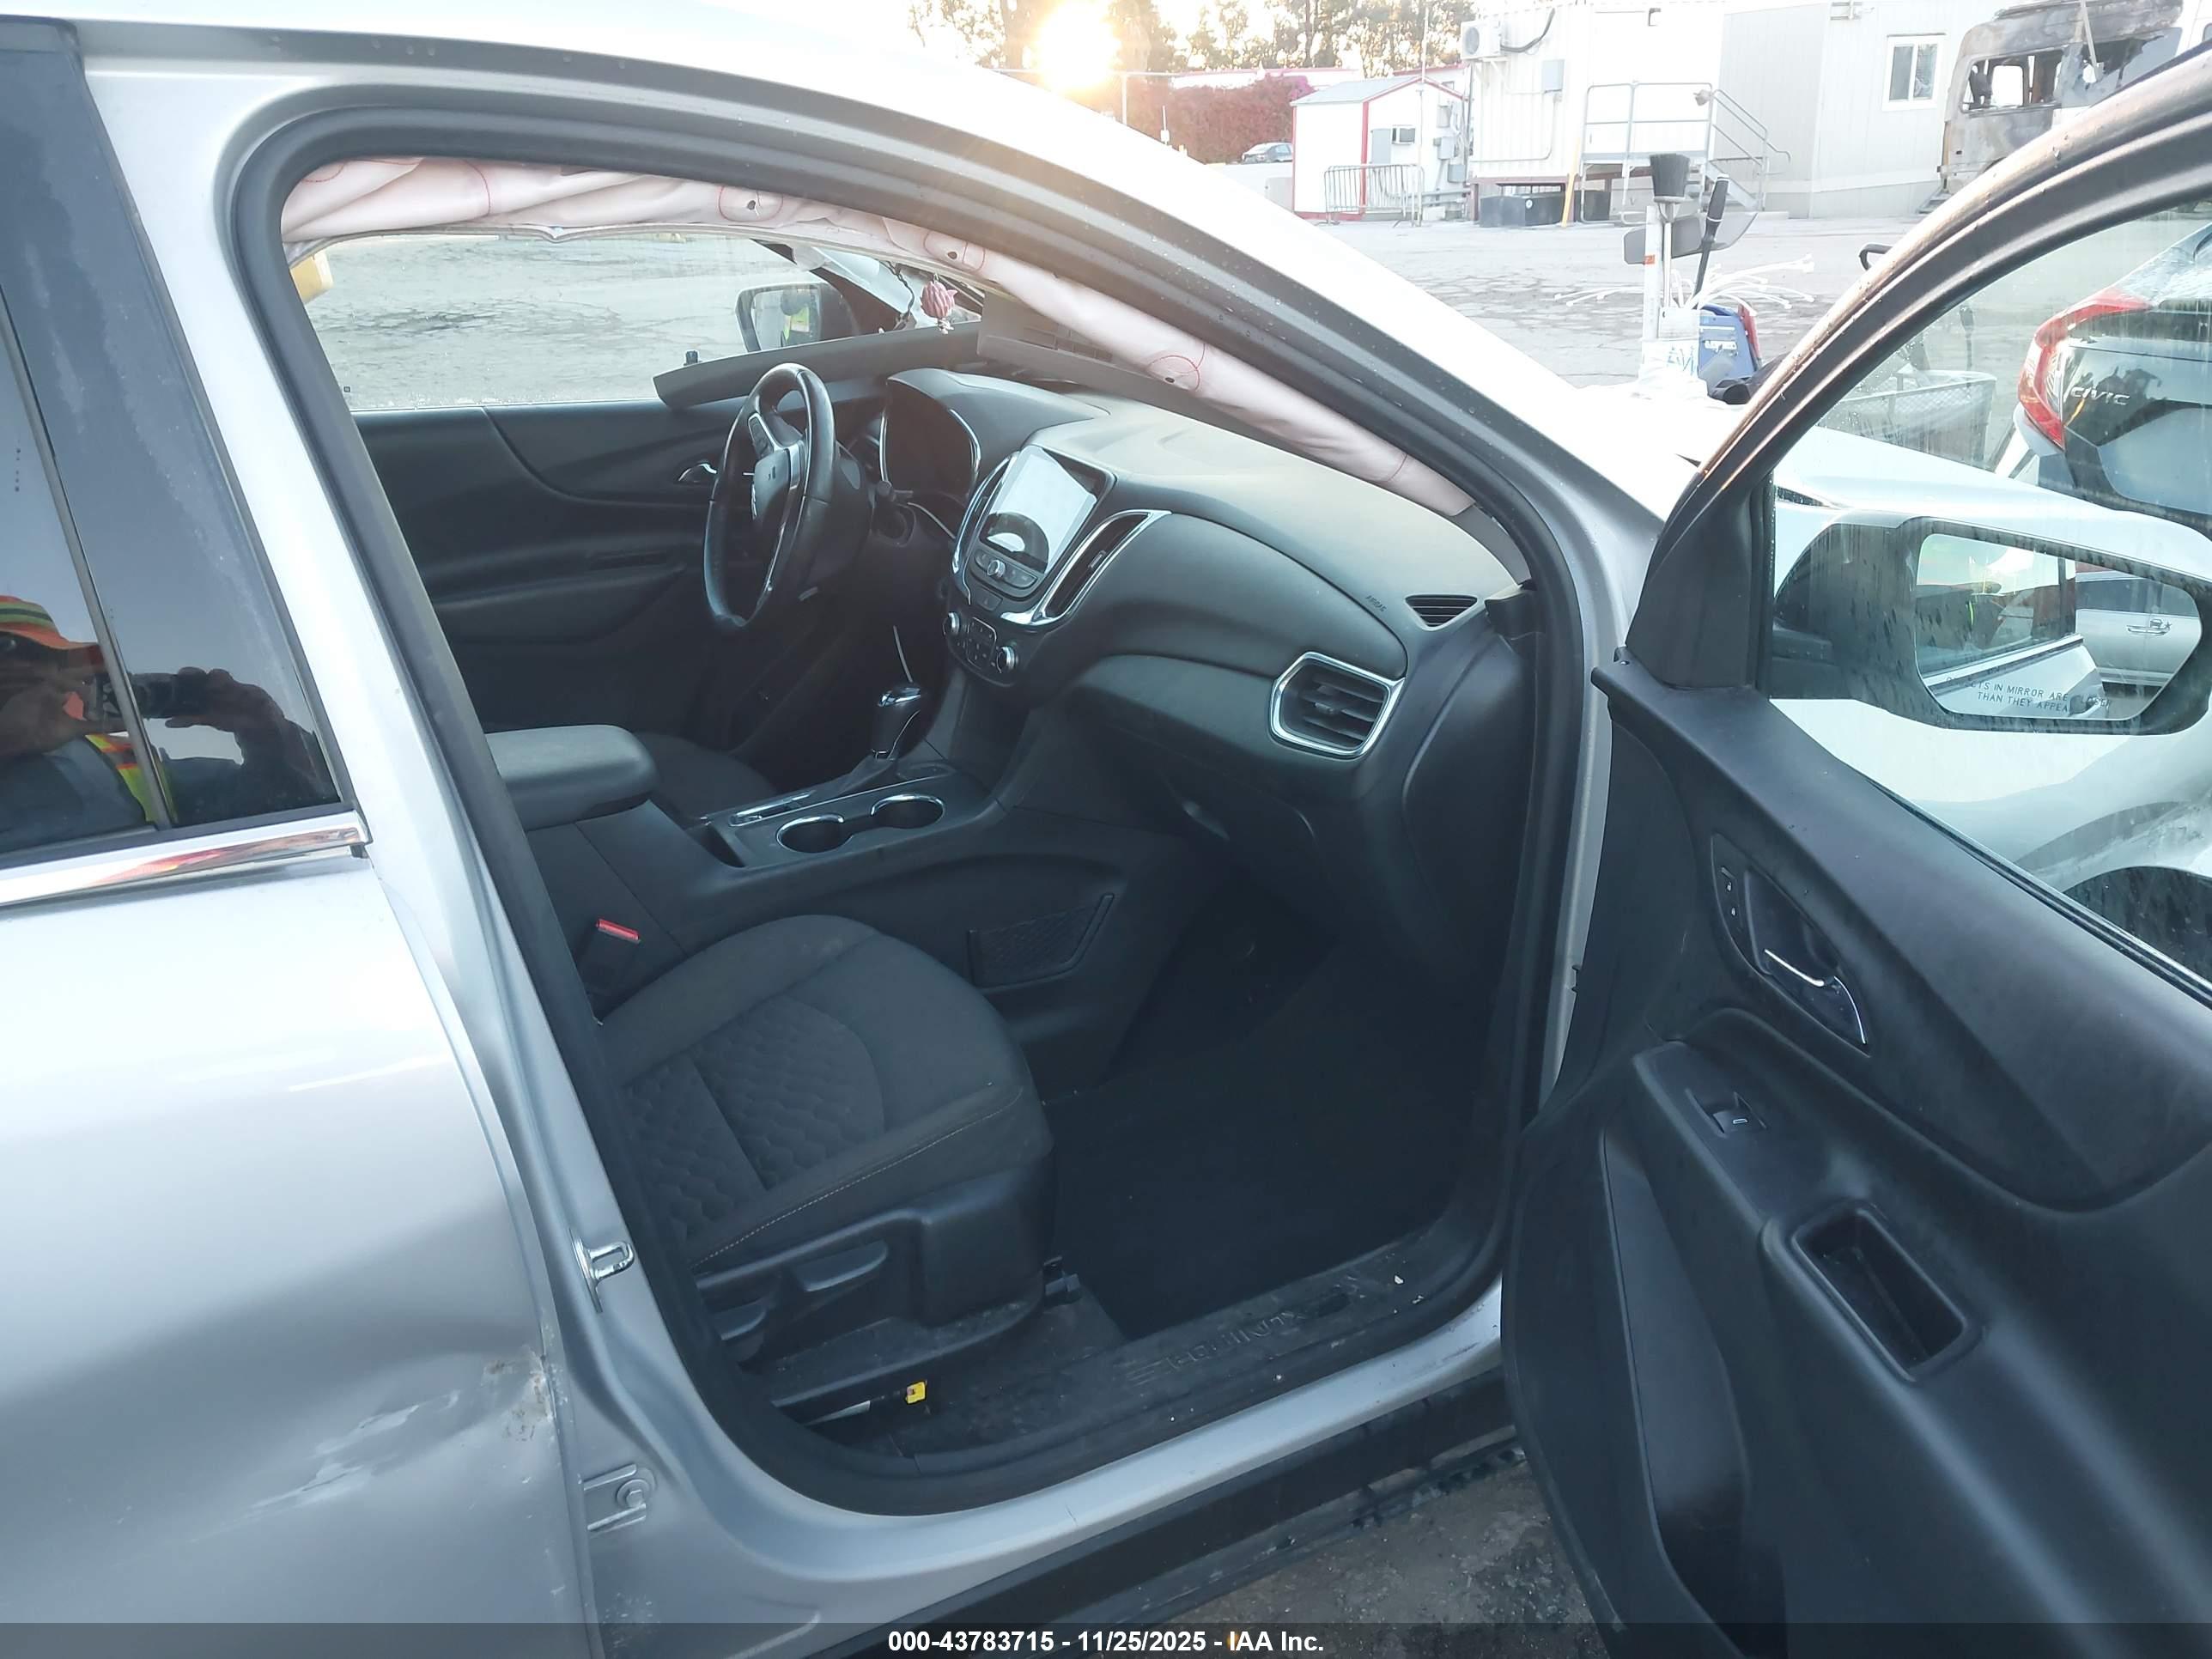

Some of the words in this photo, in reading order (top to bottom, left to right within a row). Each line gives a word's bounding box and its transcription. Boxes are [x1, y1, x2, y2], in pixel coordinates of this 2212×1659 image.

[2070, 386, 2130, 406] CIVIC
[1978, 690, 2003, 702] THAN
[2007, 695, 2033, 707] THEY
[2036, 701, 2069, 713] APPEA
[1993, 682, 2004, 692] IN
[2007, 684, 2045, 698] MIRROR
[2048, 691, 2069, 702] ARE
